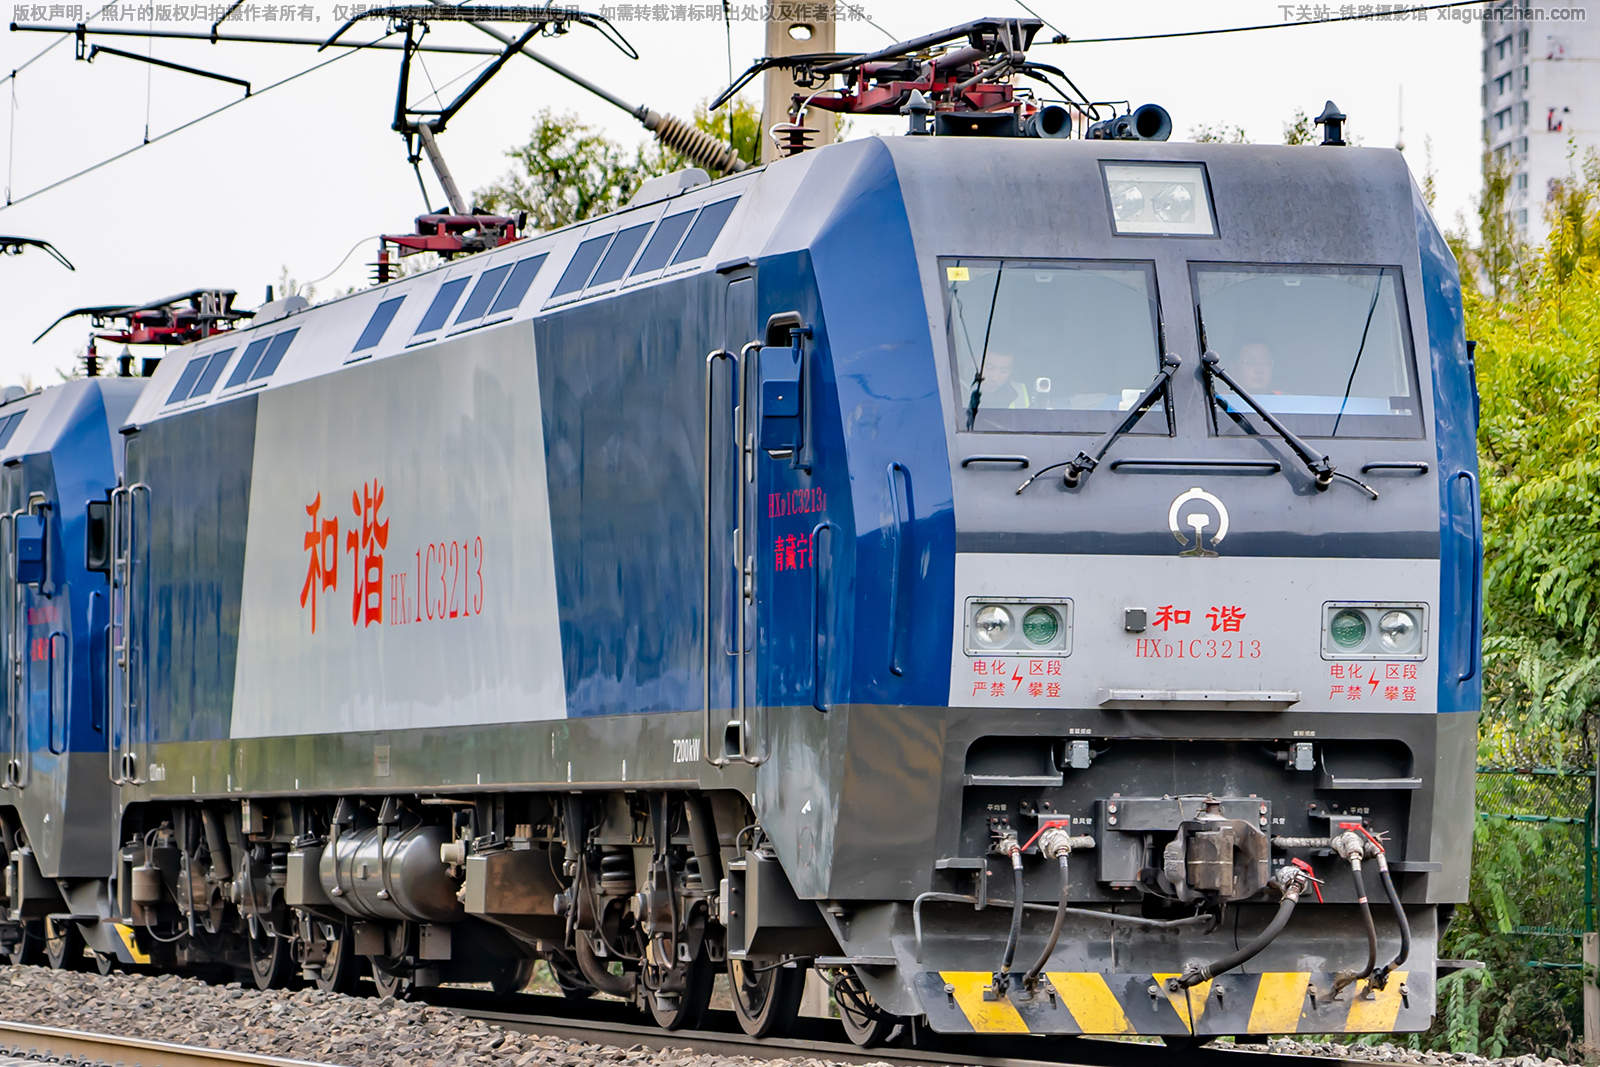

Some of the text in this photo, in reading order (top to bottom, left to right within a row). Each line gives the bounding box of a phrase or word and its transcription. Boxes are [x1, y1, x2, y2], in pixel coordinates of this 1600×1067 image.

[300, 477, 389, 635] 和谐
[1152, 604, 1247, 633] 和谐
[973, 659, 1062, 676] 电化 区段
[1330, 662, 1417, 680] 电化 区段
[972, 681, 1061, 698] 严禁 攀登
[1328, 685, 1417, 702] 严禁 攀登
[672, 738, 701, 763] 7200kW
